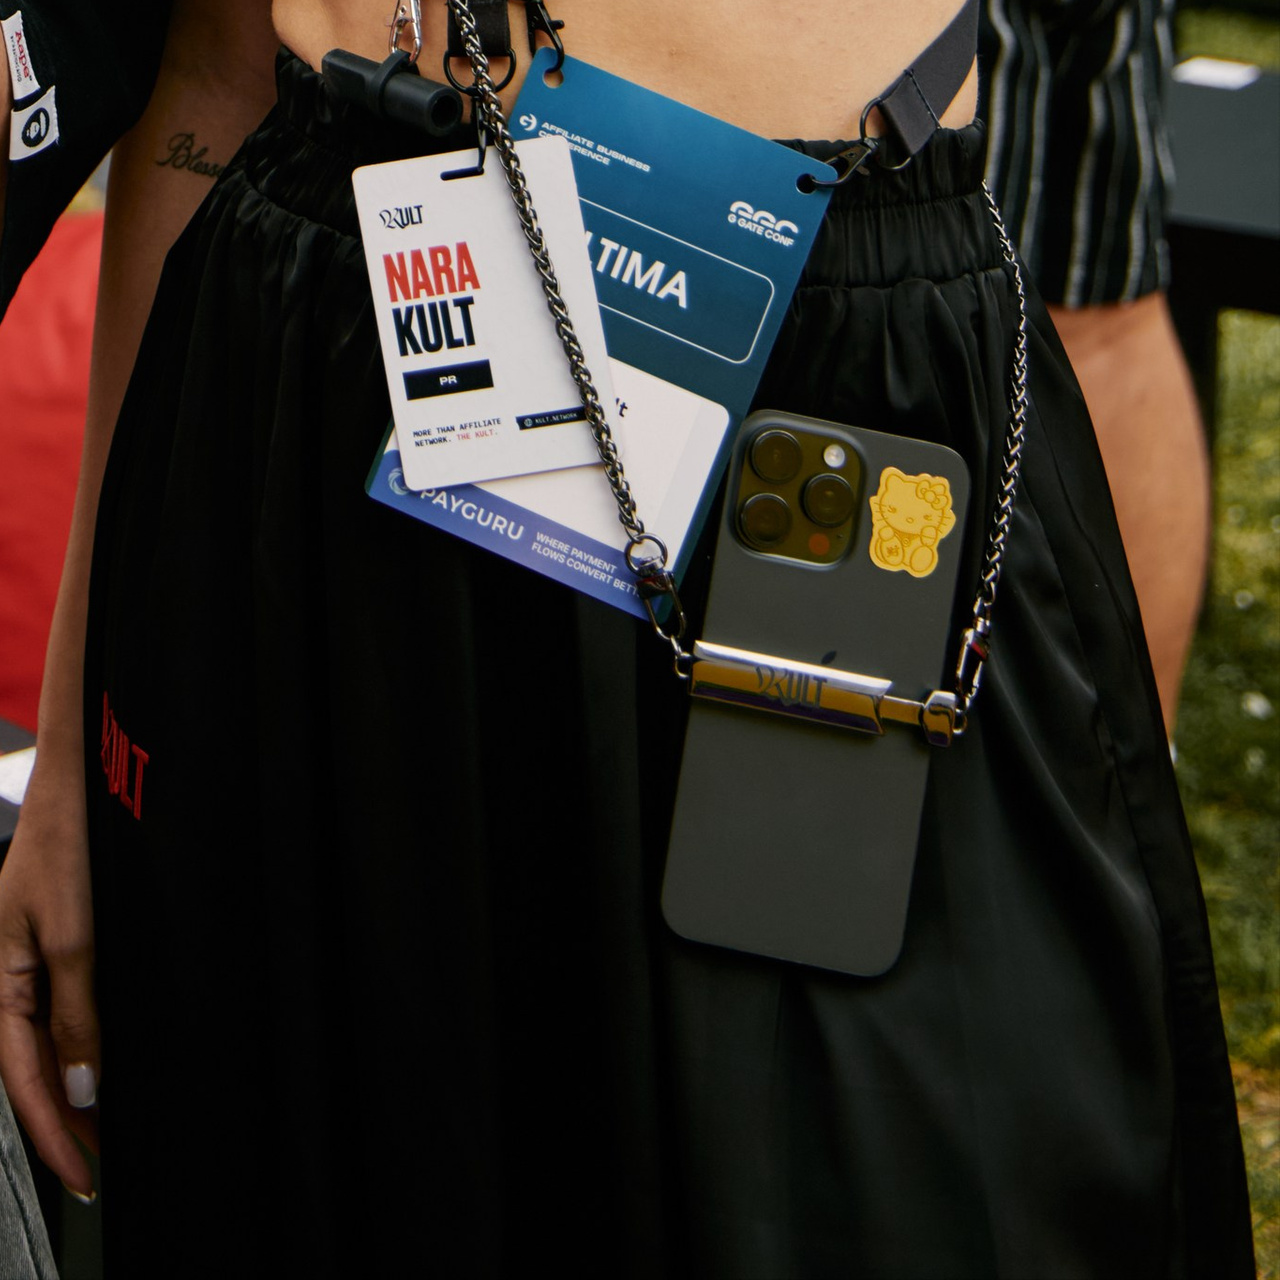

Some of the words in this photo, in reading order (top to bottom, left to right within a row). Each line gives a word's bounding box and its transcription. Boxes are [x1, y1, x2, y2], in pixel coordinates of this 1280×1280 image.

[156, 132, 226, 179] Bless
[541, 121, 594, 149] AFFILIATE
[596, 143, 651, 173] BUSINESS
[378, 204, 423, 229] KULT
[737, 217, 764, 238] GATE
[764, 228, 795, 248] CONF
[382, 241, 481, 303] NARA
[586, 230, 688, 309] TIMA
[392, 295, 476, 357] KULT
[439, 375, 458, 386] PR
[412, 427, 431, 438] MORE
[436, 423, 456, 433] THAN
[459, 417, 502, 431] AFFILIATE
[414, 435, 452, 447] NETWORK.
[456, 433, 472, 441] THE
[475, 429, 498, 439] KULT.
[420, 488, 525, 541] PAYGURU
[531, 542, 566, 564] FLOWS
[566, 556, 614, 584] CONVERT
[613, 578, 640, 598] BETT
[536, 531, 570, 554] WHERE
[570, 547, 618, 574] PAYMENT
[754, 664, 829, 709] KULT
